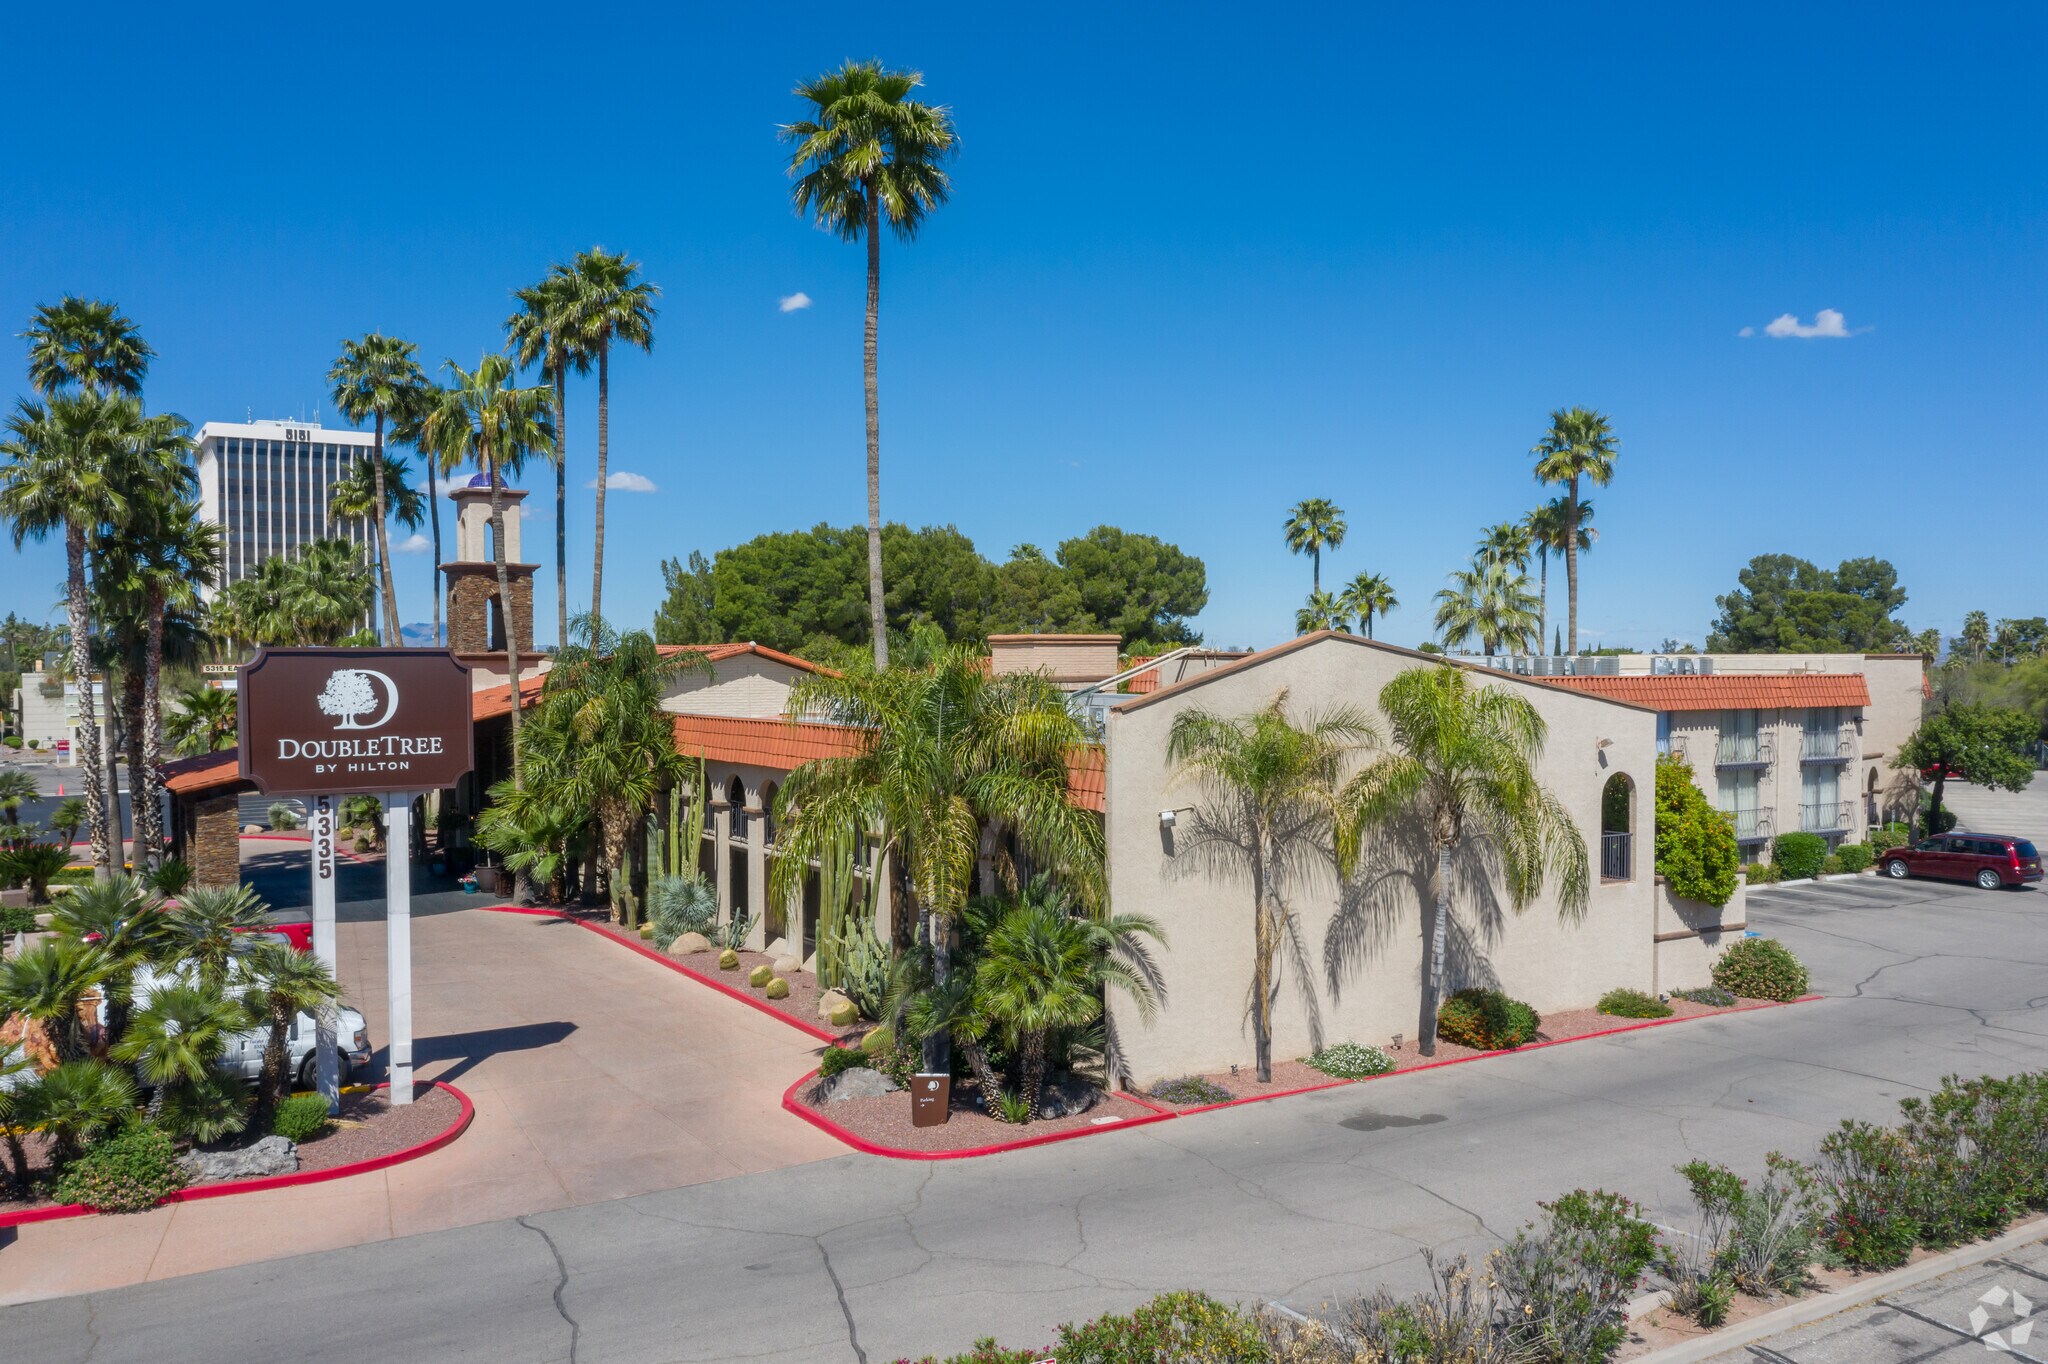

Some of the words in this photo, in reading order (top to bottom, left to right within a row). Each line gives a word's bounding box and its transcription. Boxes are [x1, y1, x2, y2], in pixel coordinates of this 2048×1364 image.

[286, 428, 311, 442] 5151
[278, 736, 443, 760] DOUBLETREE
[315, 764, 337, 774] BY
[348, 761, 410, 772] HILTON
[317, 795, 332, 880] 5335
